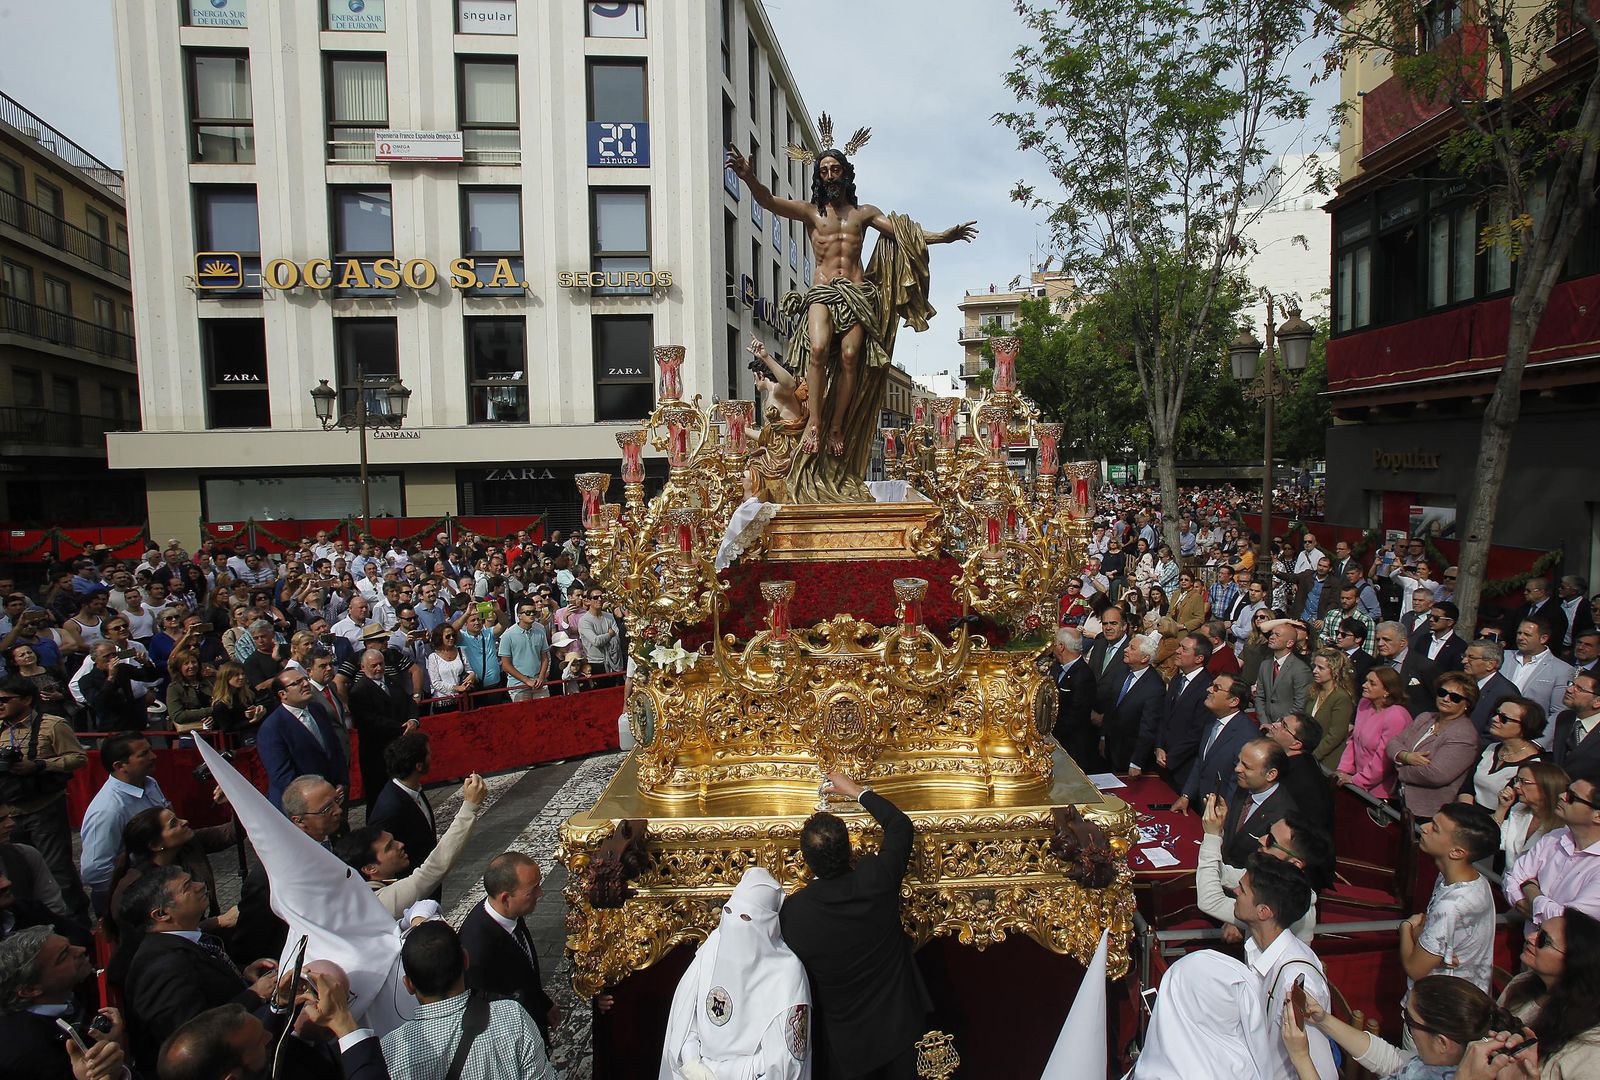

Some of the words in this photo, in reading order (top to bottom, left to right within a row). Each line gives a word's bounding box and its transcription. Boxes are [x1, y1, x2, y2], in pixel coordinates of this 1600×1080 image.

[229, 10, 246, 19] SUR
[366, 15, 383, 23] SUR
[197, 17, 209, 25] DE
[210, 18, 242, 26] EUROPA
[336, 21, 347, 29] DE
[348, 22, 379, 30] EUROPA
[599, 123, 636, 157] 20
[599, 156, 638, 164] minutos
[264, 257, 437, 291] OCASO
[450, 257, 530, 289] S.A.
[557, 270, 674, 288] SEGUROS
[608, 367, 643, 375] ZARA
[223, 373, 260, 381] ZARA
[373, 431, 420, 439] CAMPANA
[1372, 447, 1440, 475] Popular
[485, 467, 557, 481] ZARA
